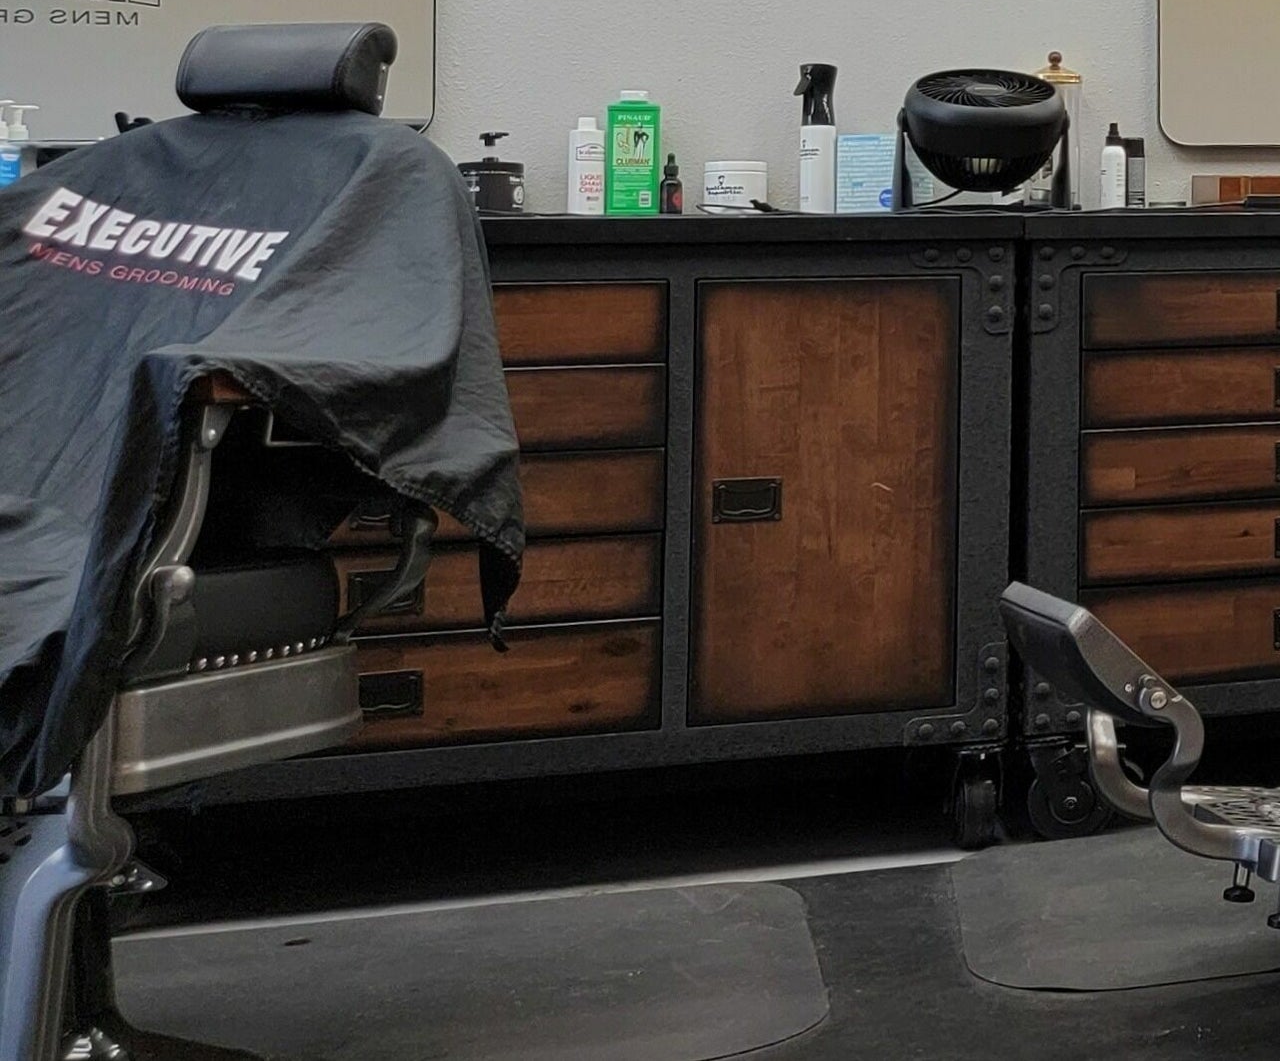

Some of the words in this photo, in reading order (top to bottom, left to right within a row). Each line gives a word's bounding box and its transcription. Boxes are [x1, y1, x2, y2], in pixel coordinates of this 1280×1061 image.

[23, 186, 290, 282] EXECUTIVE
[28, 241, 105, 275] MENS
[109, 265, 236, 297] GROOMING
